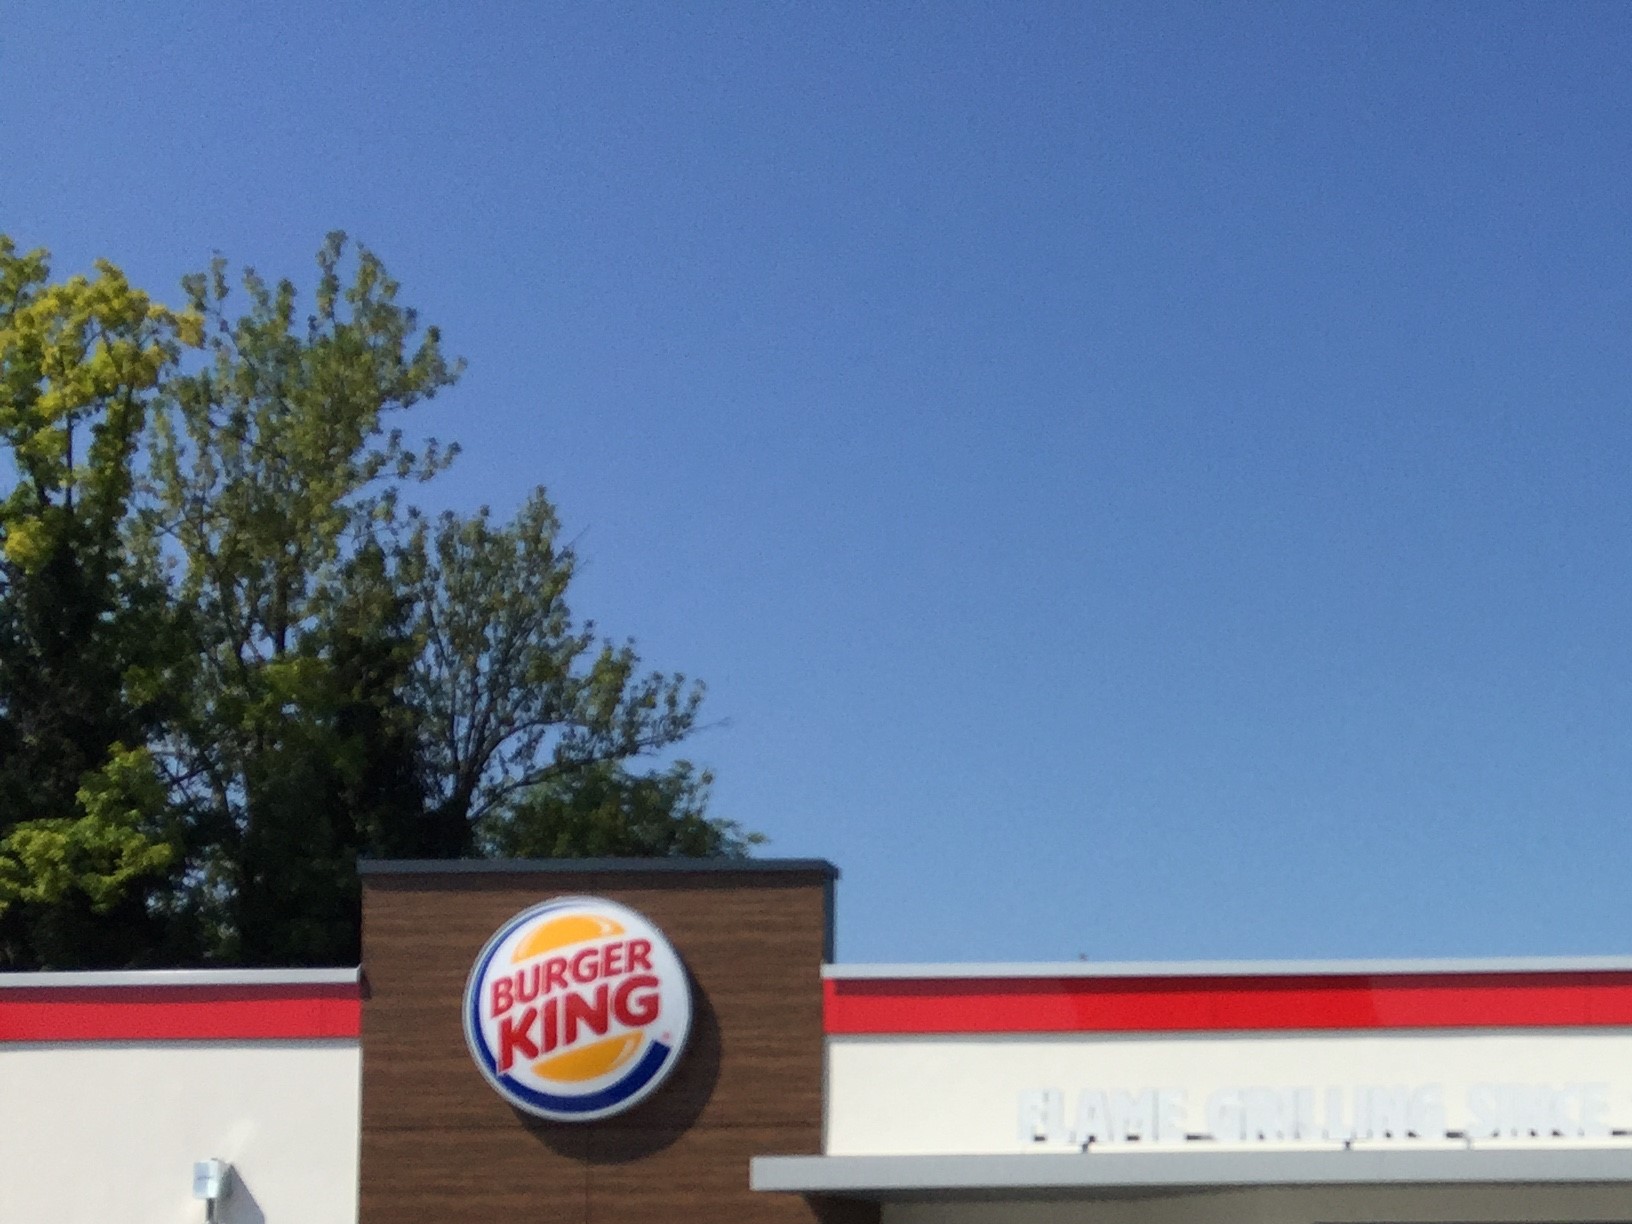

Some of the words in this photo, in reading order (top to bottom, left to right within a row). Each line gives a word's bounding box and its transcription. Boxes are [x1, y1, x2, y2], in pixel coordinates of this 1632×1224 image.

[491, 938, 652, 1018] BURGER
[498, 974, 660, 1072] KING
[1017, 1085, 1188, 1142] FLAME
[1204, 1084, 1445, 1141] GRILLING
[1465, 1083, 1609, 1139] SINCE
